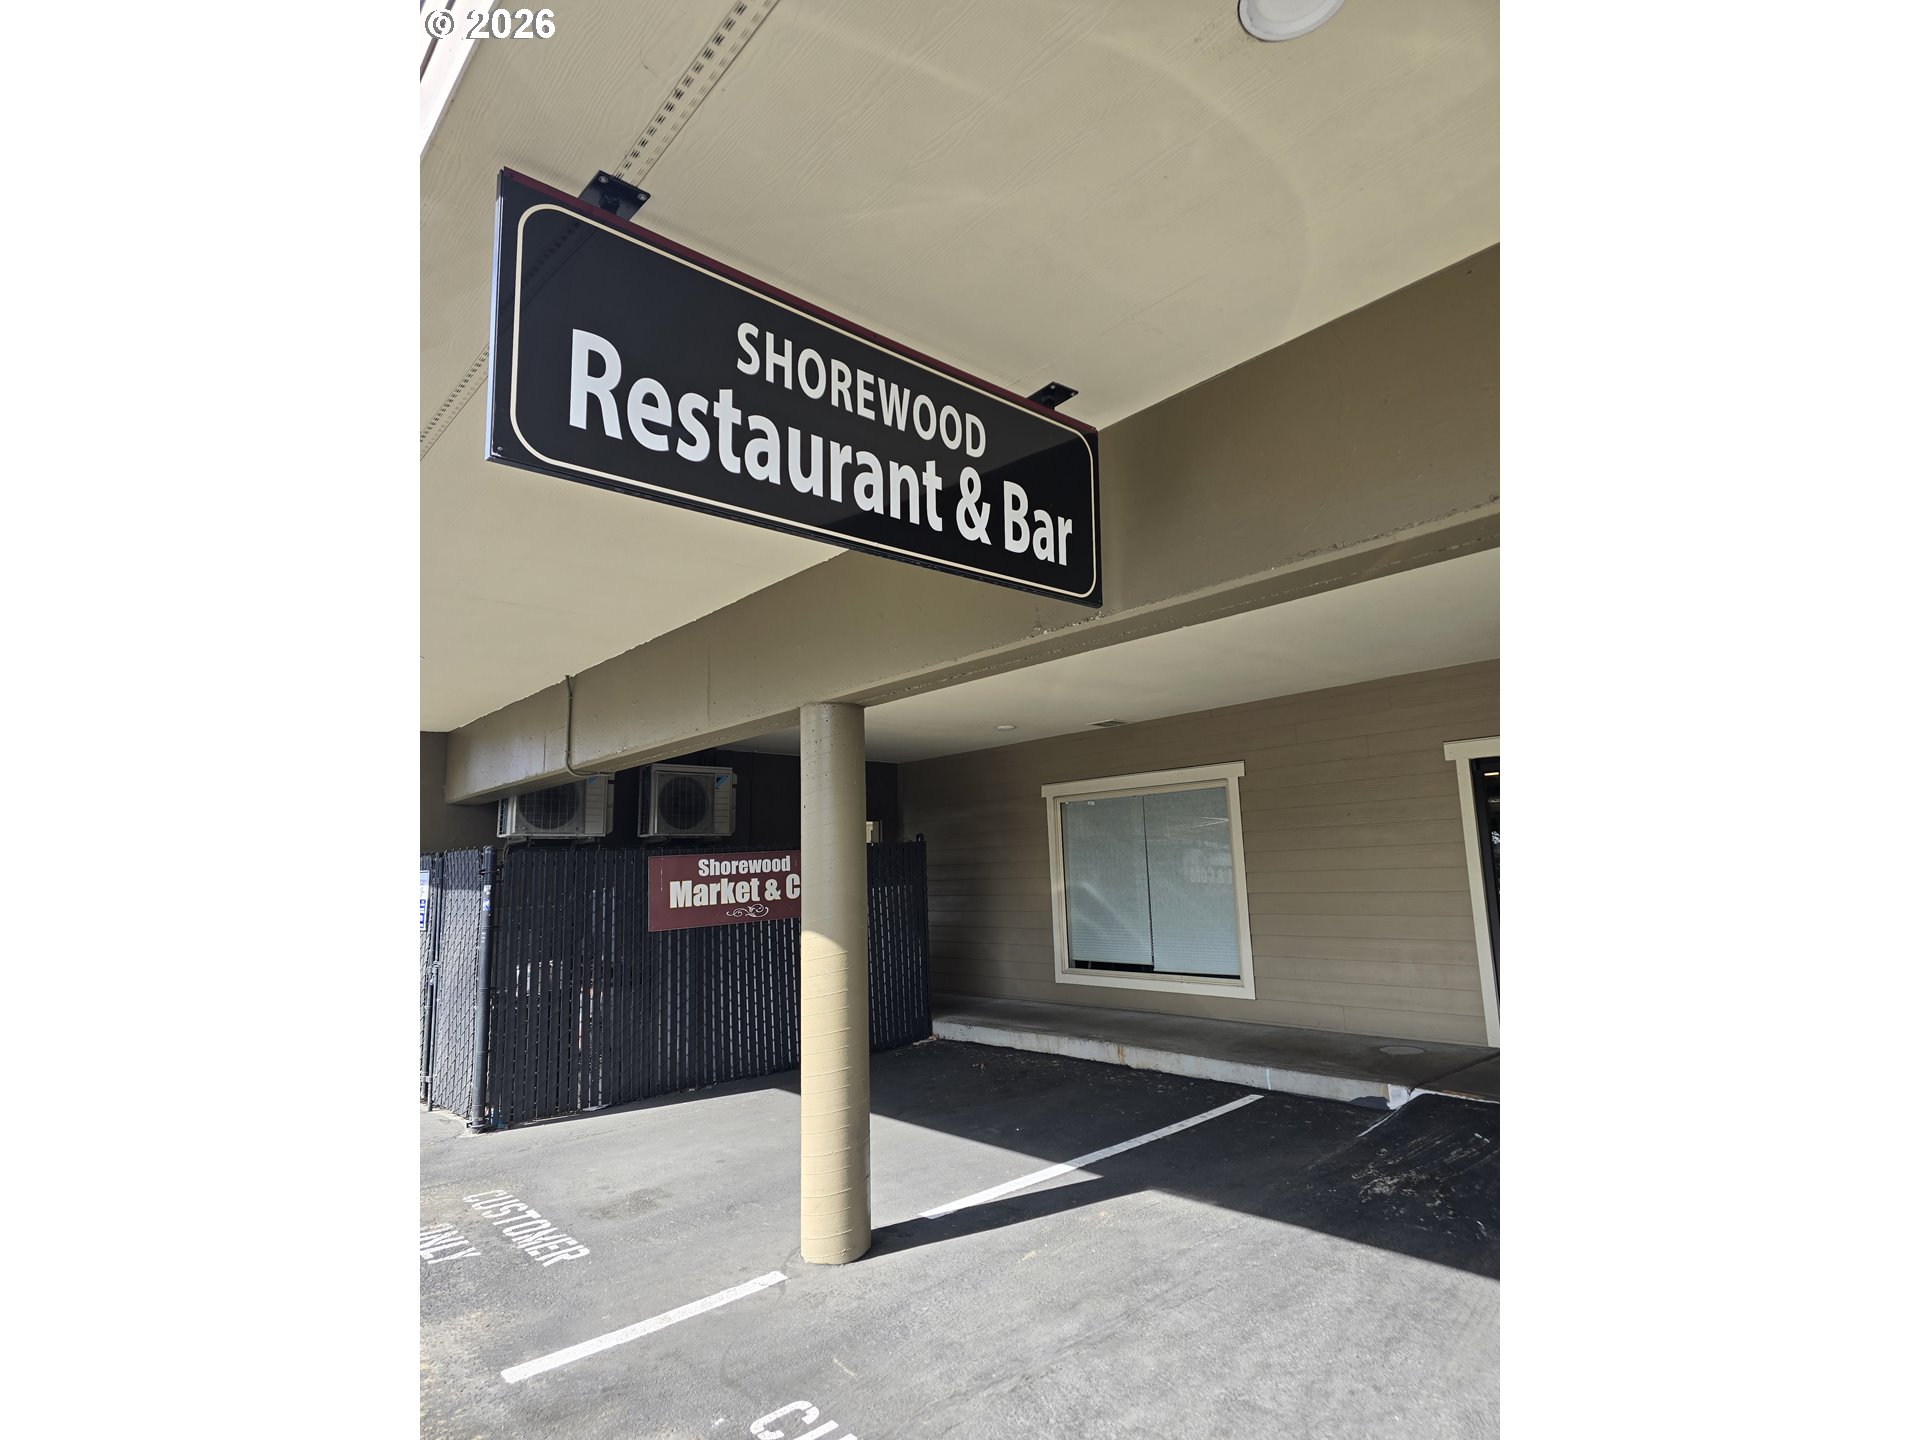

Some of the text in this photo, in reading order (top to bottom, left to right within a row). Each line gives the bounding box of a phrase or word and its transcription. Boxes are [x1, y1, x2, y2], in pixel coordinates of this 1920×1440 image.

[736, 322, 987, 458] SHOREWOOD
[569, 328, 1073, 567] Restaurant & Bar
[669, 877, 760, 909] Market
[764, 878, 781, 901] &
[698, 855, 791, 877] Shorewood
[463, 1189, 590, 1267] CUSTOMER
